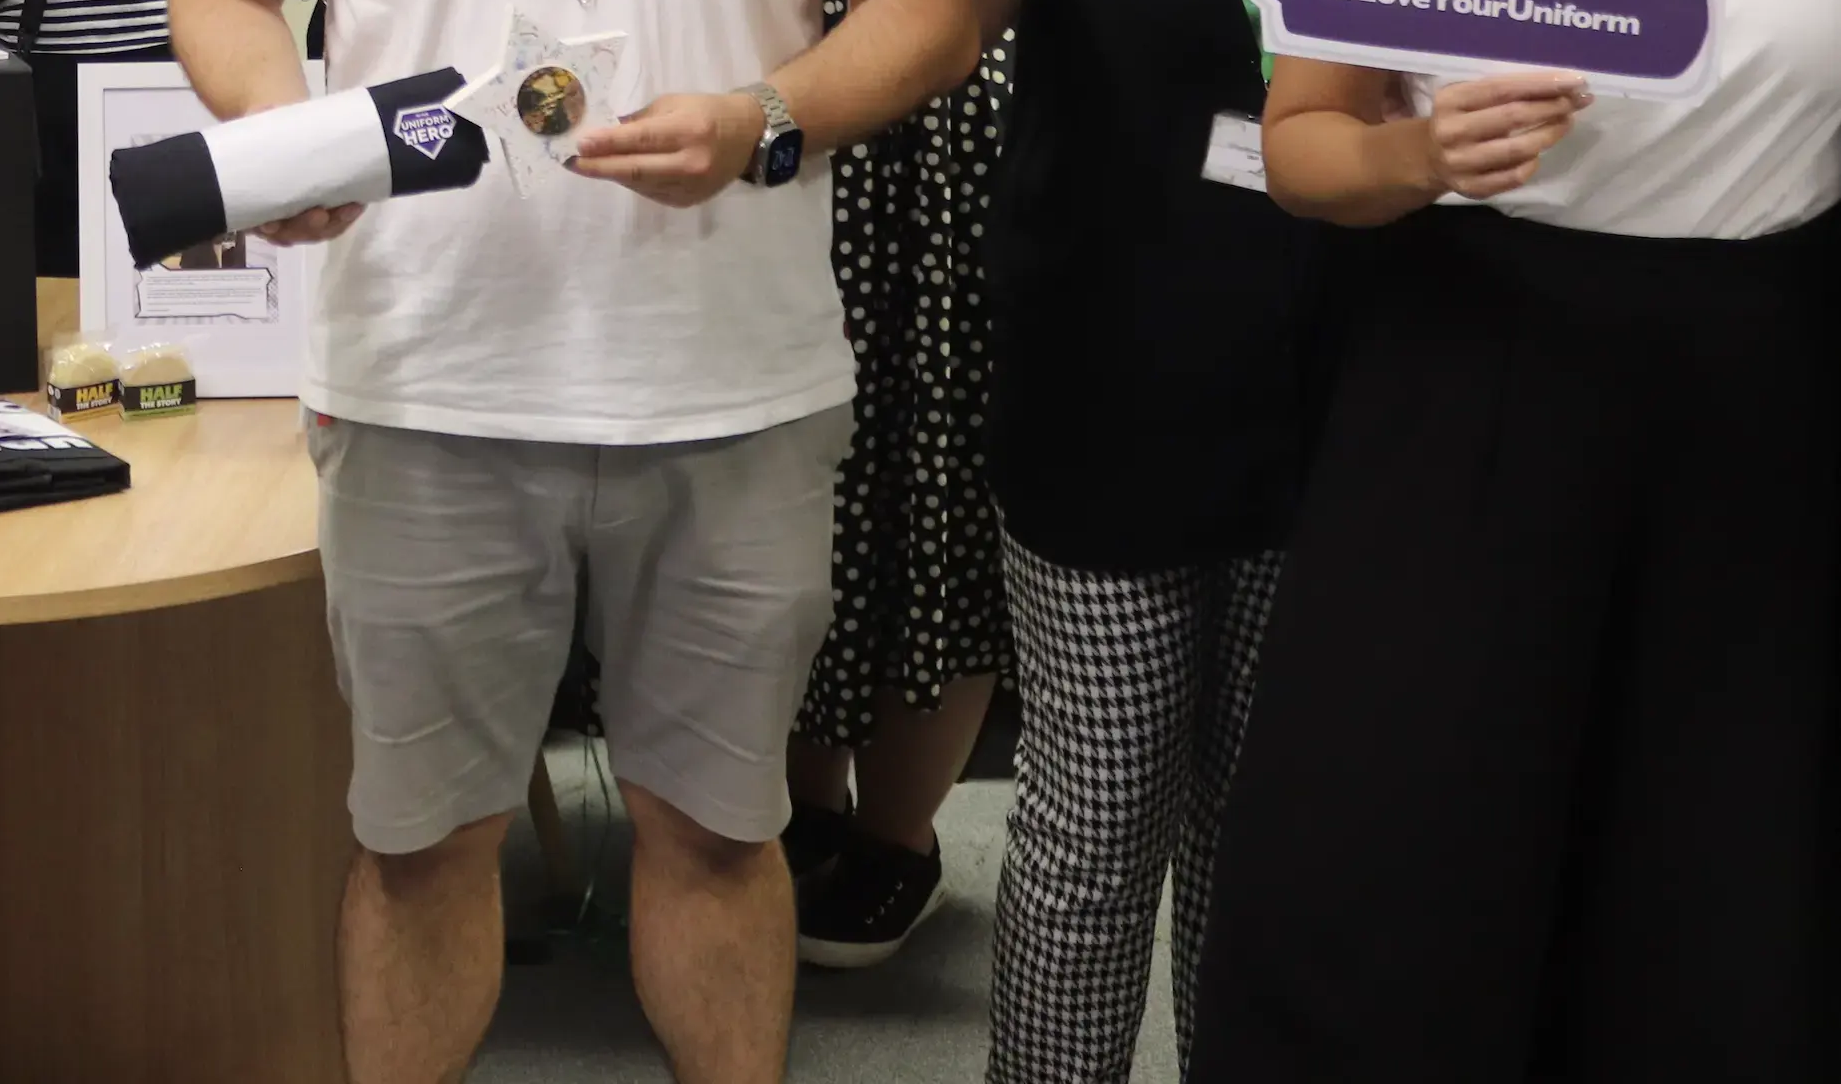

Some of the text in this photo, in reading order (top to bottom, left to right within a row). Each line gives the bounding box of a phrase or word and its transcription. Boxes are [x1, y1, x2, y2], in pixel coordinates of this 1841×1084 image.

[400, 115, 451, 132] UNIFORM
[403, 124, 454, 146] HERO
[75, 383, 114, 402] HALF
[139, 383, 183, 402] HALF
[75, 397, 113, 410] THE STORY
[140, 397, 182, 409] THE STORY
